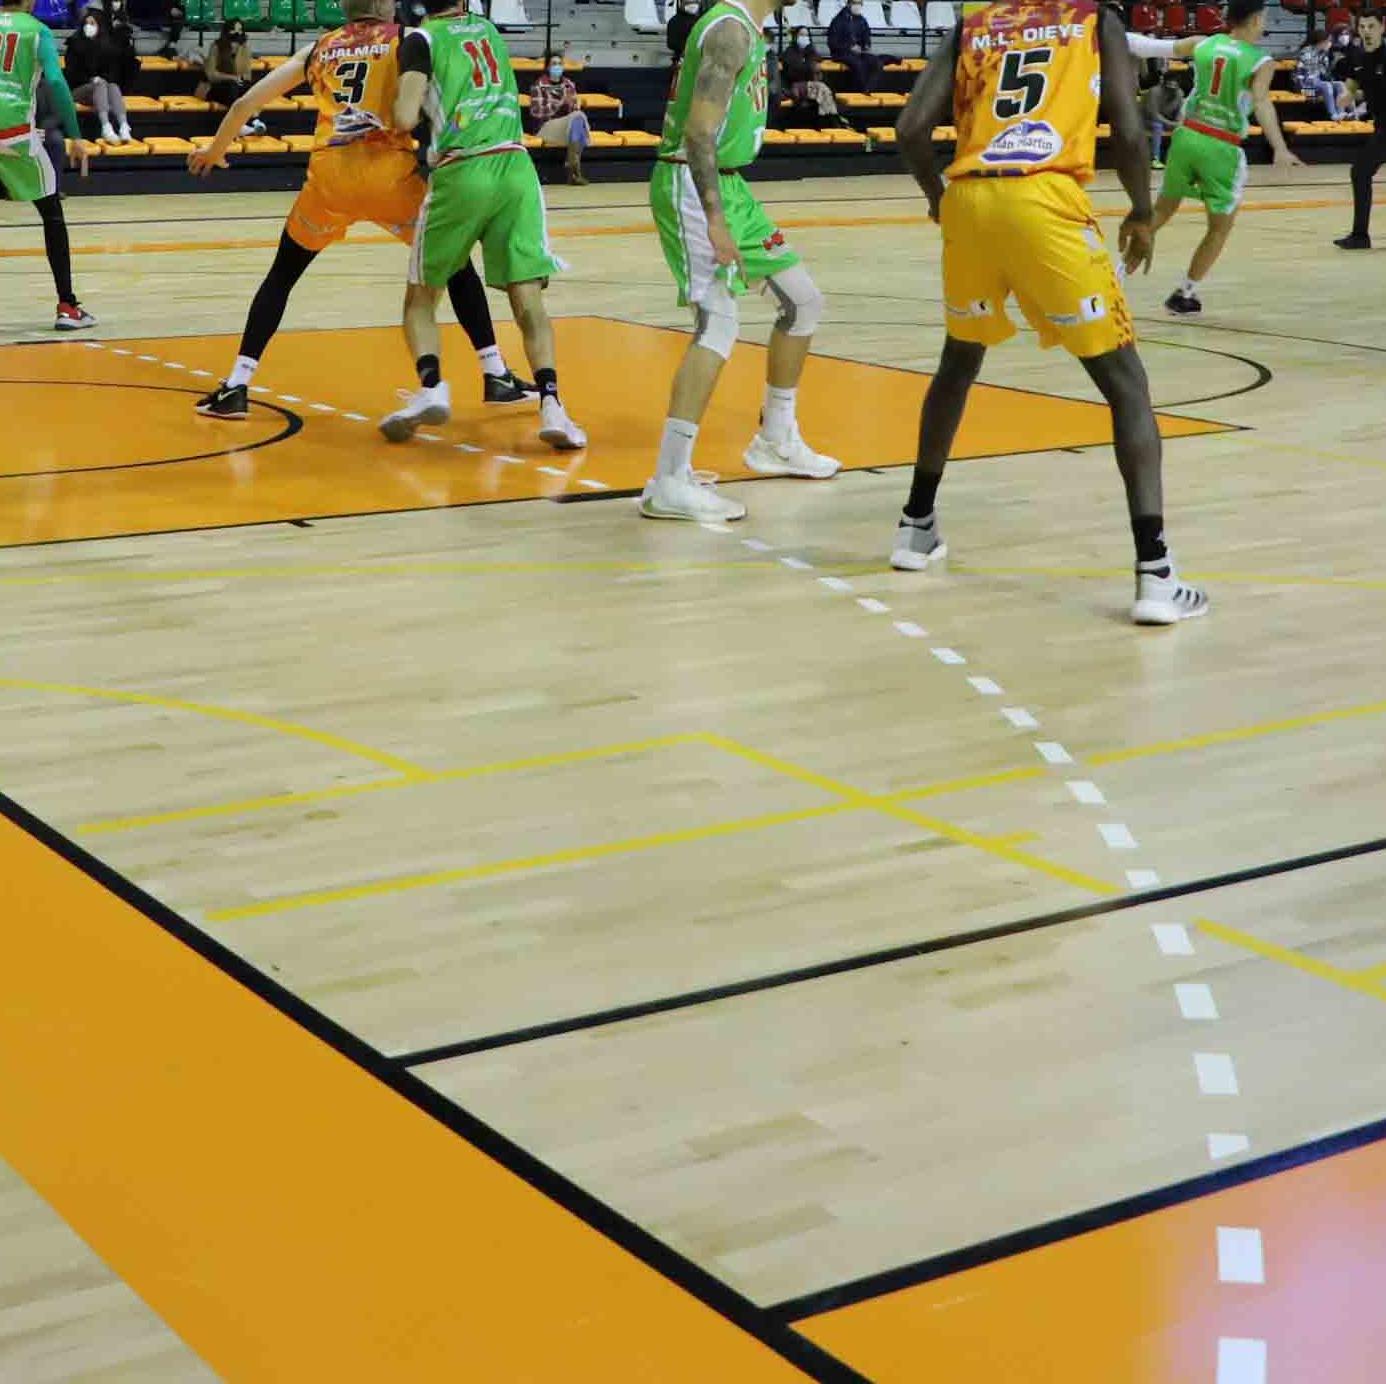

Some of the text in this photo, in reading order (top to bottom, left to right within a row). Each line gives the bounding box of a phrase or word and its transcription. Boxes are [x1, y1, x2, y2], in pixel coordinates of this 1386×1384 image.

[332, 60, 369, 104] 3
[461, 37, 501, 89] 11
[993, 47, 1054, 121] 5
[1210, 56, 1227, 97] 1
